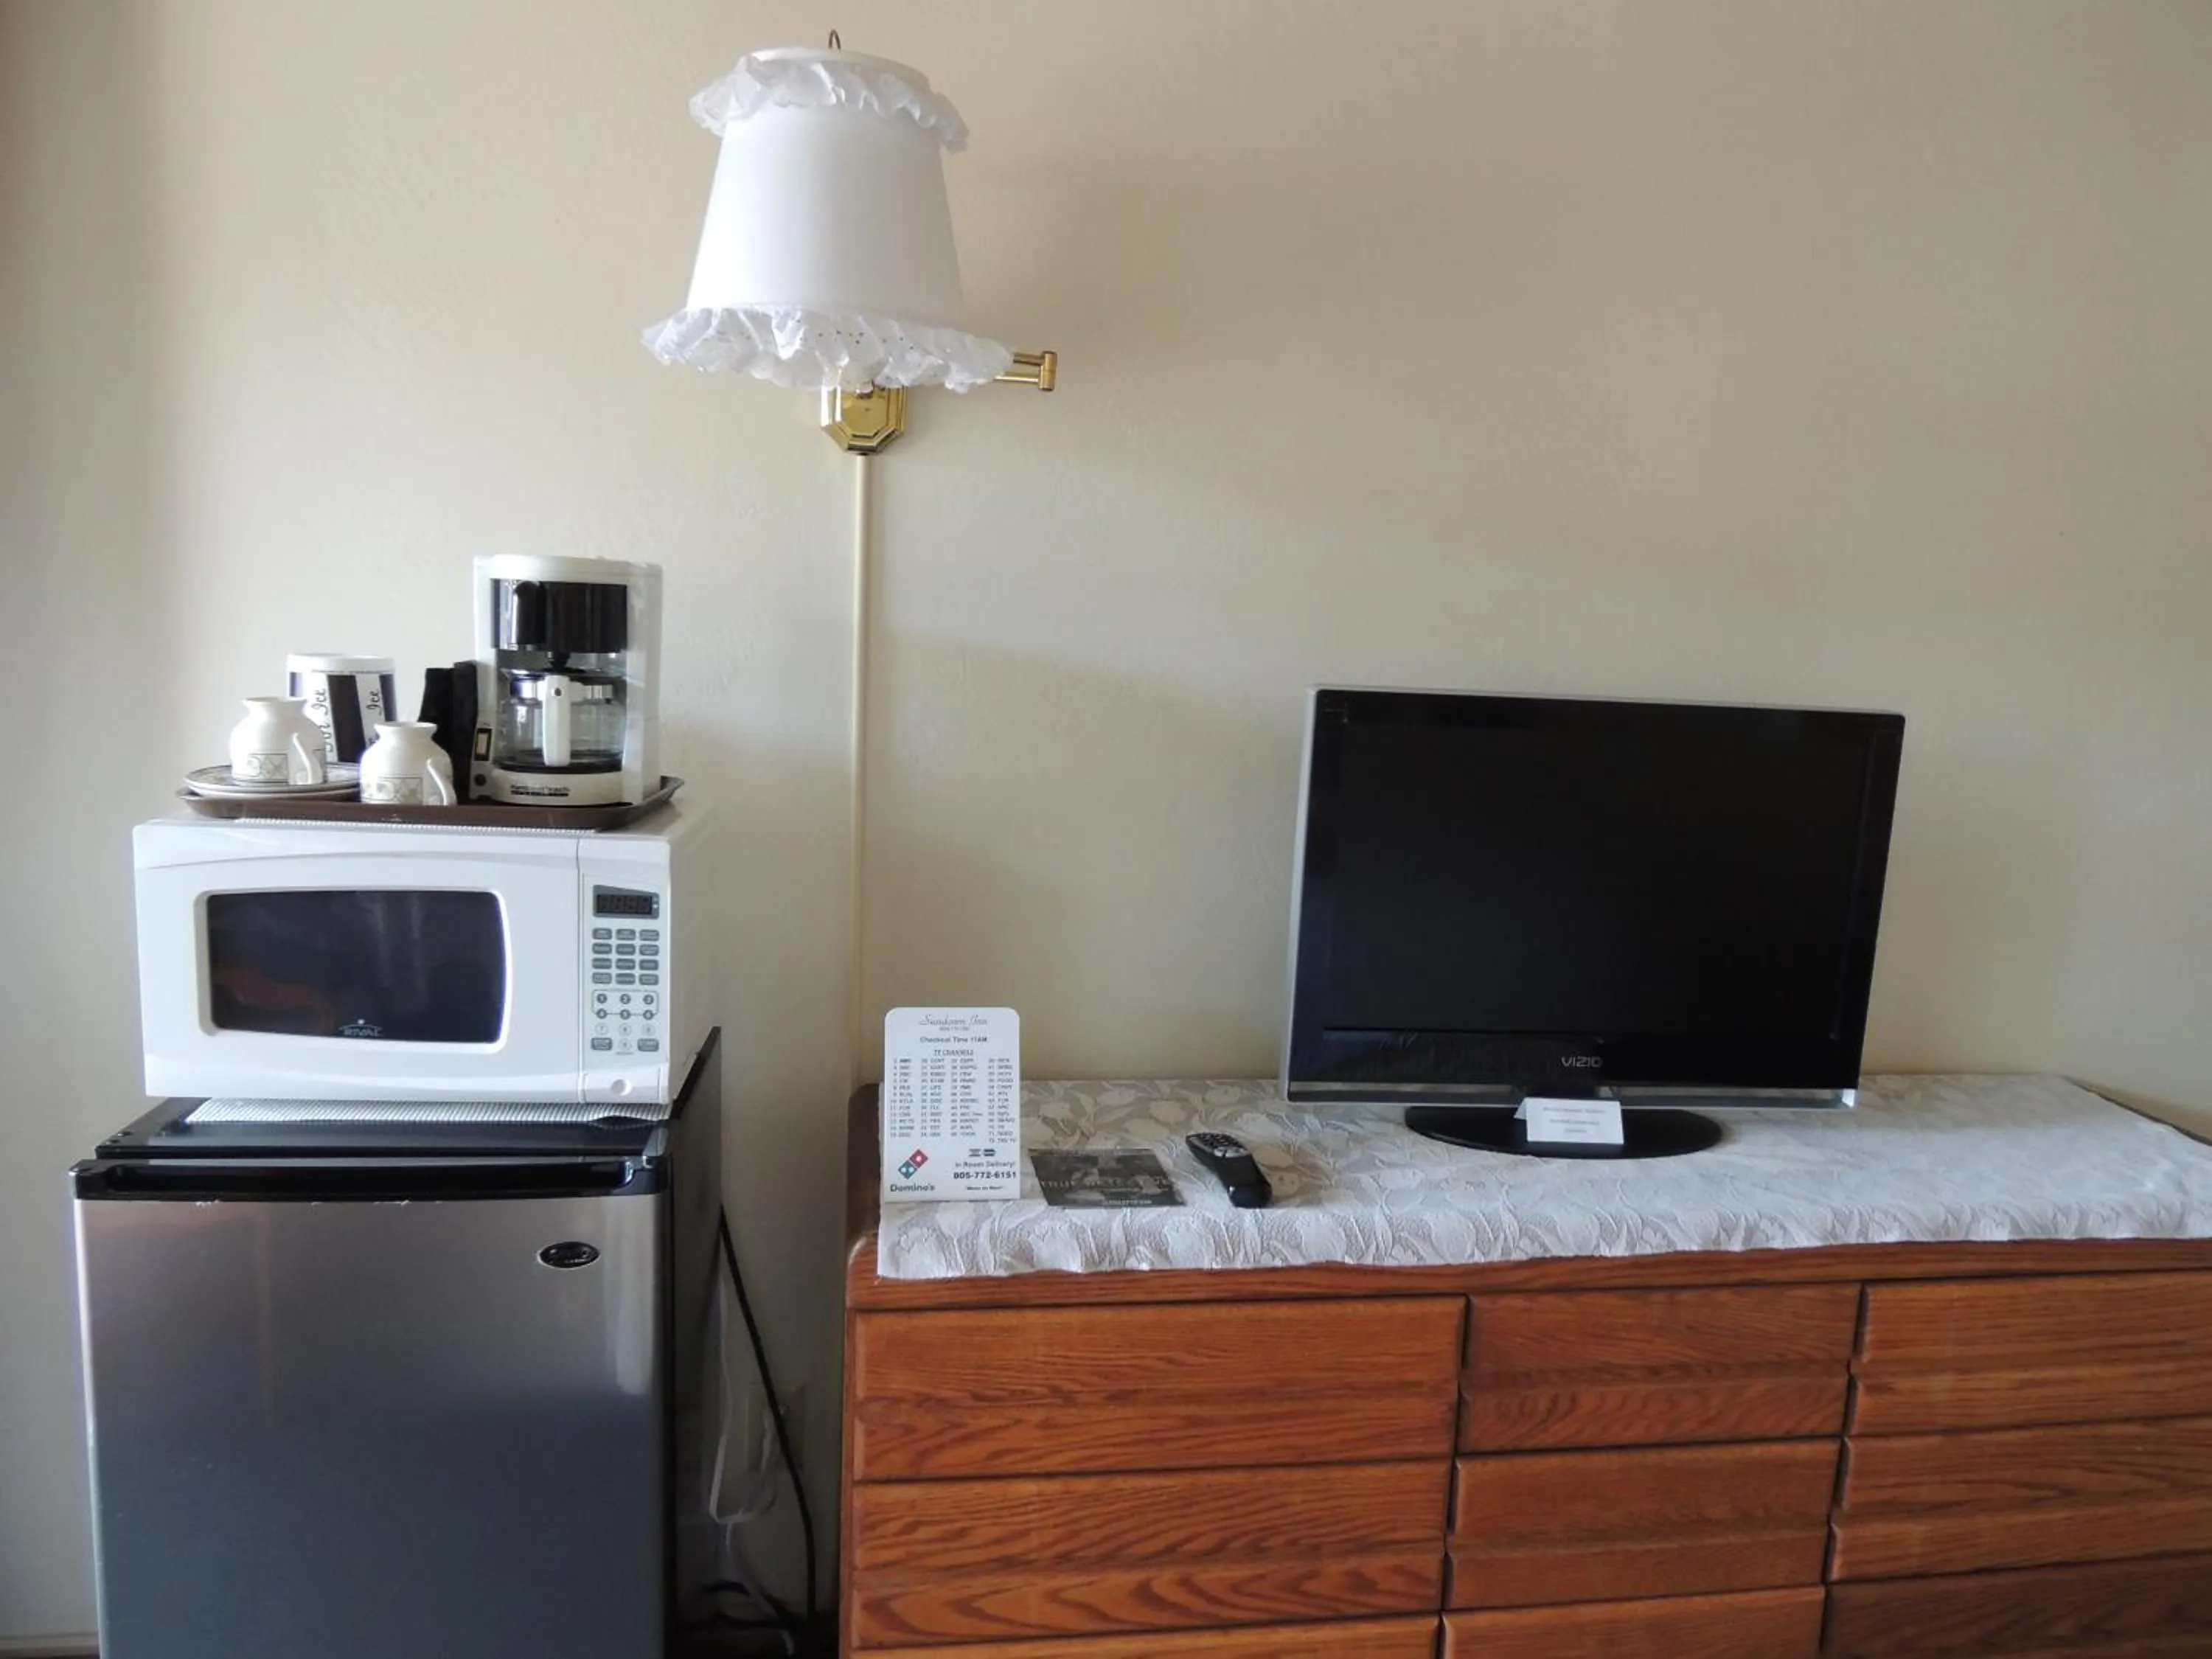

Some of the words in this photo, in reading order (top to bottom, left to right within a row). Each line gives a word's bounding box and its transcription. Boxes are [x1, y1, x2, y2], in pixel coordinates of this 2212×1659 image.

[365, 688, 382, 715] Ice
[1560, 1055, 1603, 1068] VIZIO
[890, 1182, 936, 1192] Domino's
